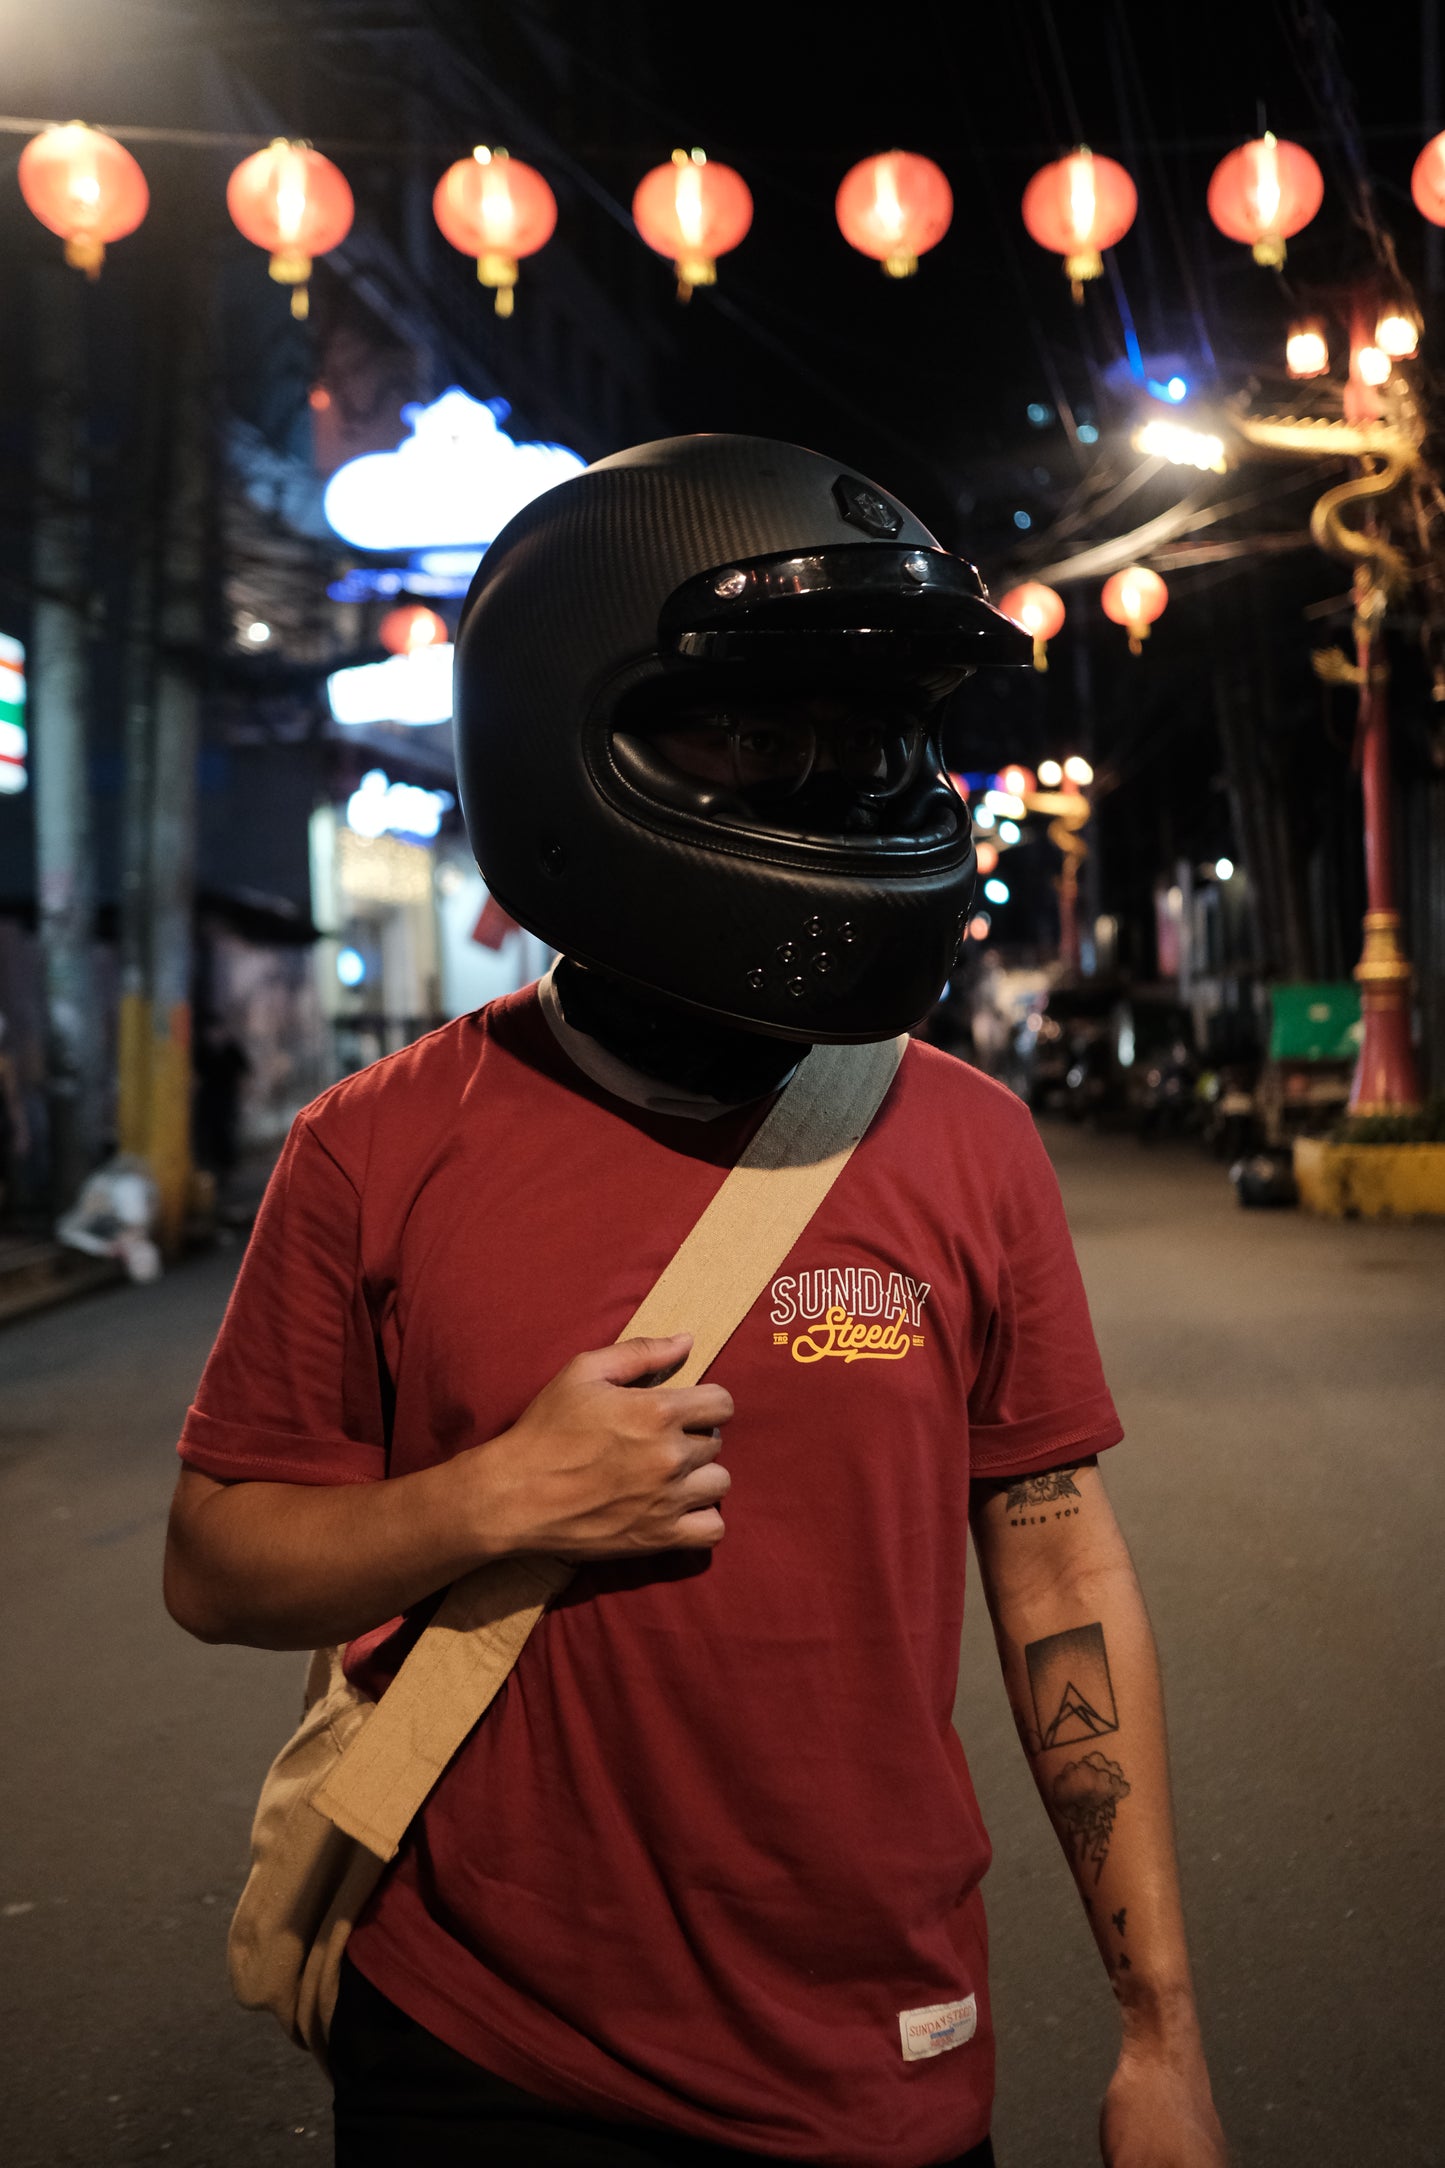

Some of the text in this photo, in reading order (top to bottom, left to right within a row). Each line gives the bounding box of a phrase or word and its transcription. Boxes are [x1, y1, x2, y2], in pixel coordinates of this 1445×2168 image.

[770, 1268, 931, 1327] SUNDAY
[792, 1306, 910, 1363] Steed
[1055, 1506, 1079, 1520] YOU
